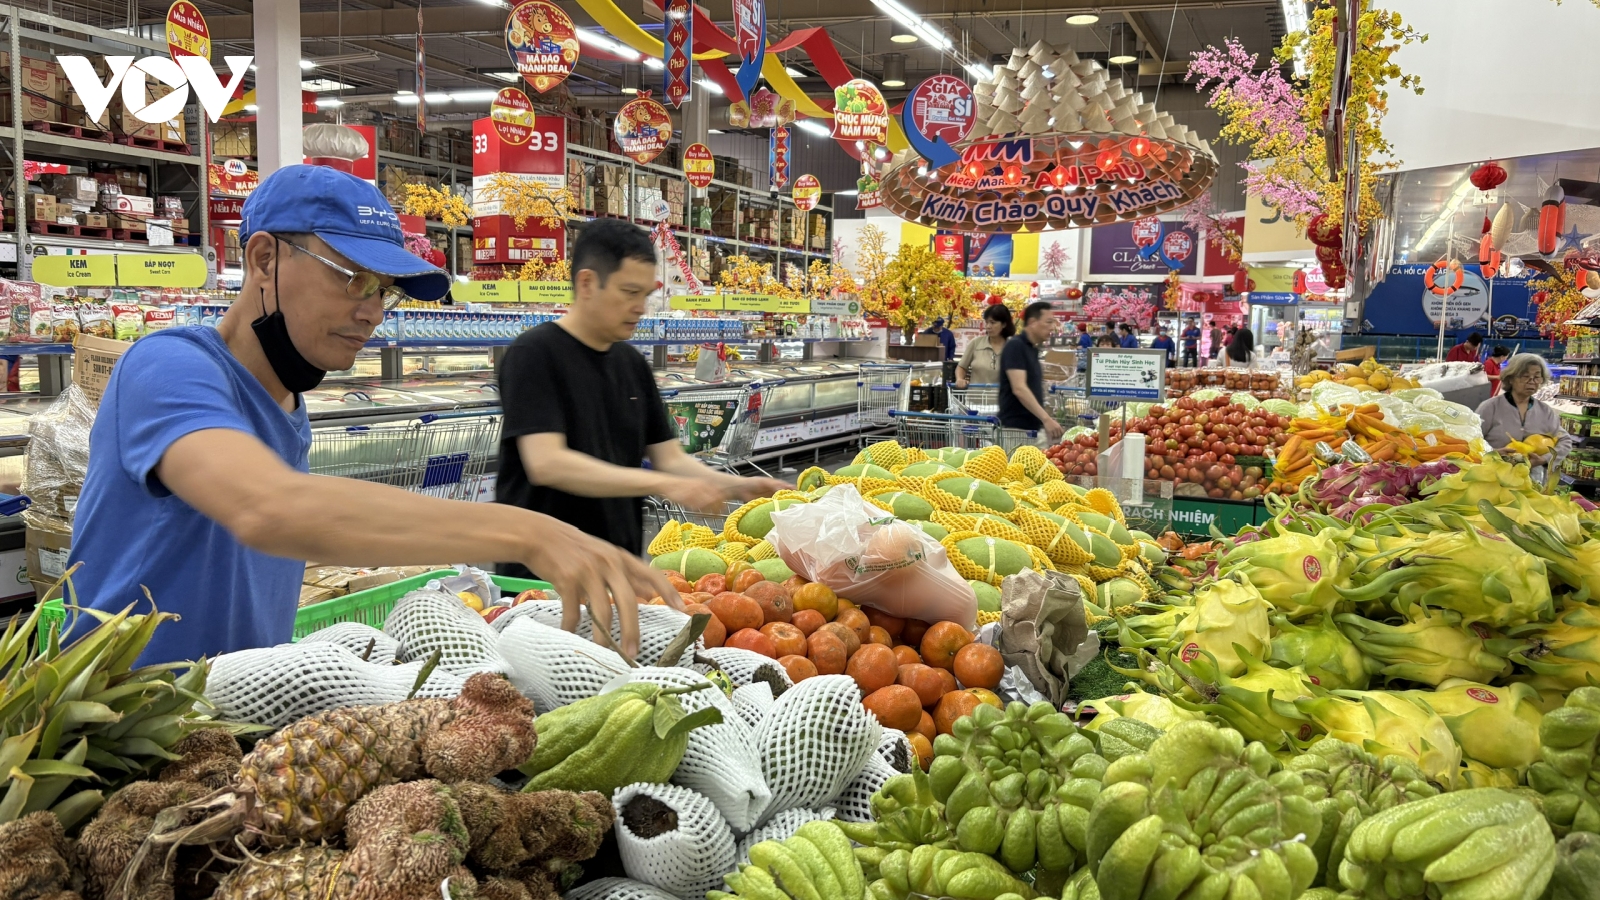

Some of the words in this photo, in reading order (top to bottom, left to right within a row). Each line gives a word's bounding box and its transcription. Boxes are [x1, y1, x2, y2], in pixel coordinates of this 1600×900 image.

[173, 10, 186, 24] Mua
[187, 17, 204, 32] Nhiều
[517, 62, 547, 72] THÀNH
[548, 65, 569, 74] DEAL
[670, 58, 685, 70] Phát
[672, 86, 682, 96] Tài
[932, 82, 958, 94] GIÁ
[954, 94, 972, 117] SỈ
[836, 112, 859, 124] CHÚC
[840, 124, 860, 136] NĂM
[475, 134, 487, 154] 33
[528, 131, 558, 151] 33
[920, 194, 968, 222] Kính
[973, 199, 1040, 224] Chào
[1046, 193, 1100, 220] Quý
[1109, 182, 1181, 214] Khách
[70, 259, 87, 268] KEM
[158, 261, 175, 269] NGỌT
[1168, 510, 1215, 526] NHIỆM
